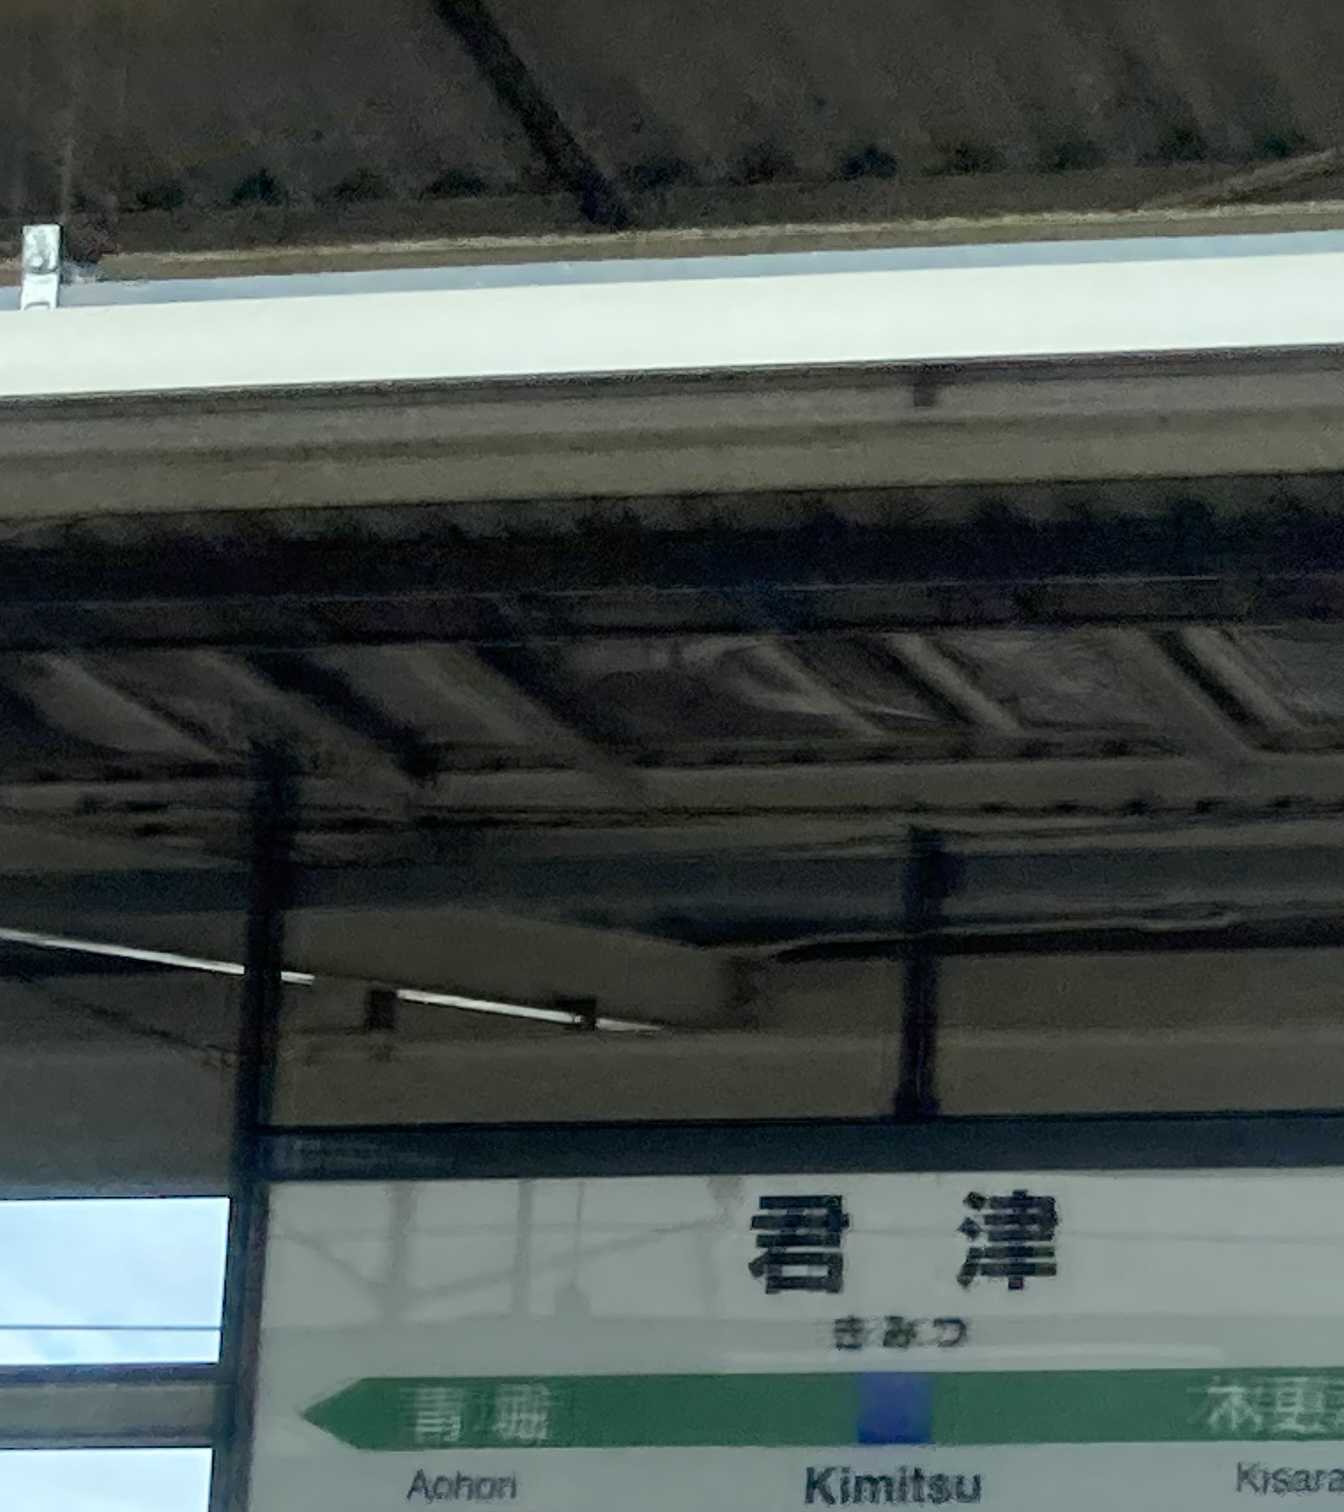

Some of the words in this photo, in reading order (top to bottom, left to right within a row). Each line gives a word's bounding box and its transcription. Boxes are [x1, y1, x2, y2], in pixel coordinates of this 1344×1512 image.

[748, 1189, 1058, 1294] 君津
[833, 1316, 968, 1350] きみつ
[805, 1465, 982, 1505] Kimitsu
